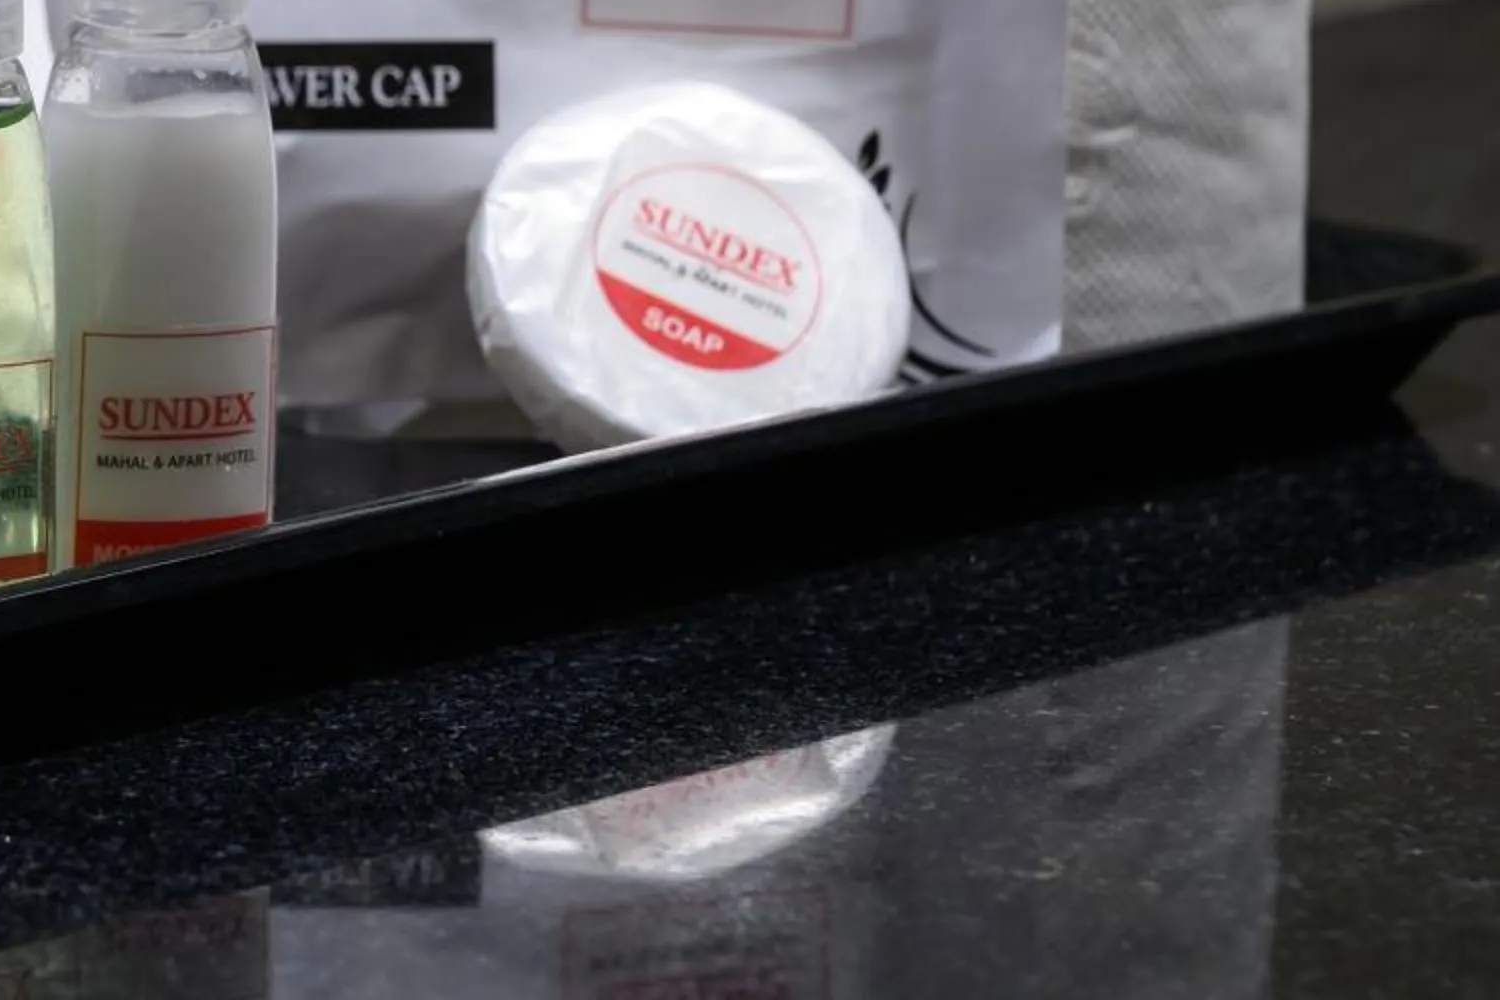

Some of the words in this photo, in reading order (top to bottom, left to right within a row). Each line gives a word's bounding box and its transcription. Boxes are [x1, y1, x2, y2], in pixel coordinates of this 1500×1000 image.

[263, 65, 364, 108] WER
[370, 64, 462, 109] CAP
[633, 198, 803, 288] SUNDEX
[641, 305, 725, 356] SOAP
[98, 391, 257, 432] SUNDEX
[97, 453, 149, 470] MAHAL
[152, 454, 164, 470] &
[167, 453, 213, 469] APART
[216, 448, 258, 466] HOTEL
